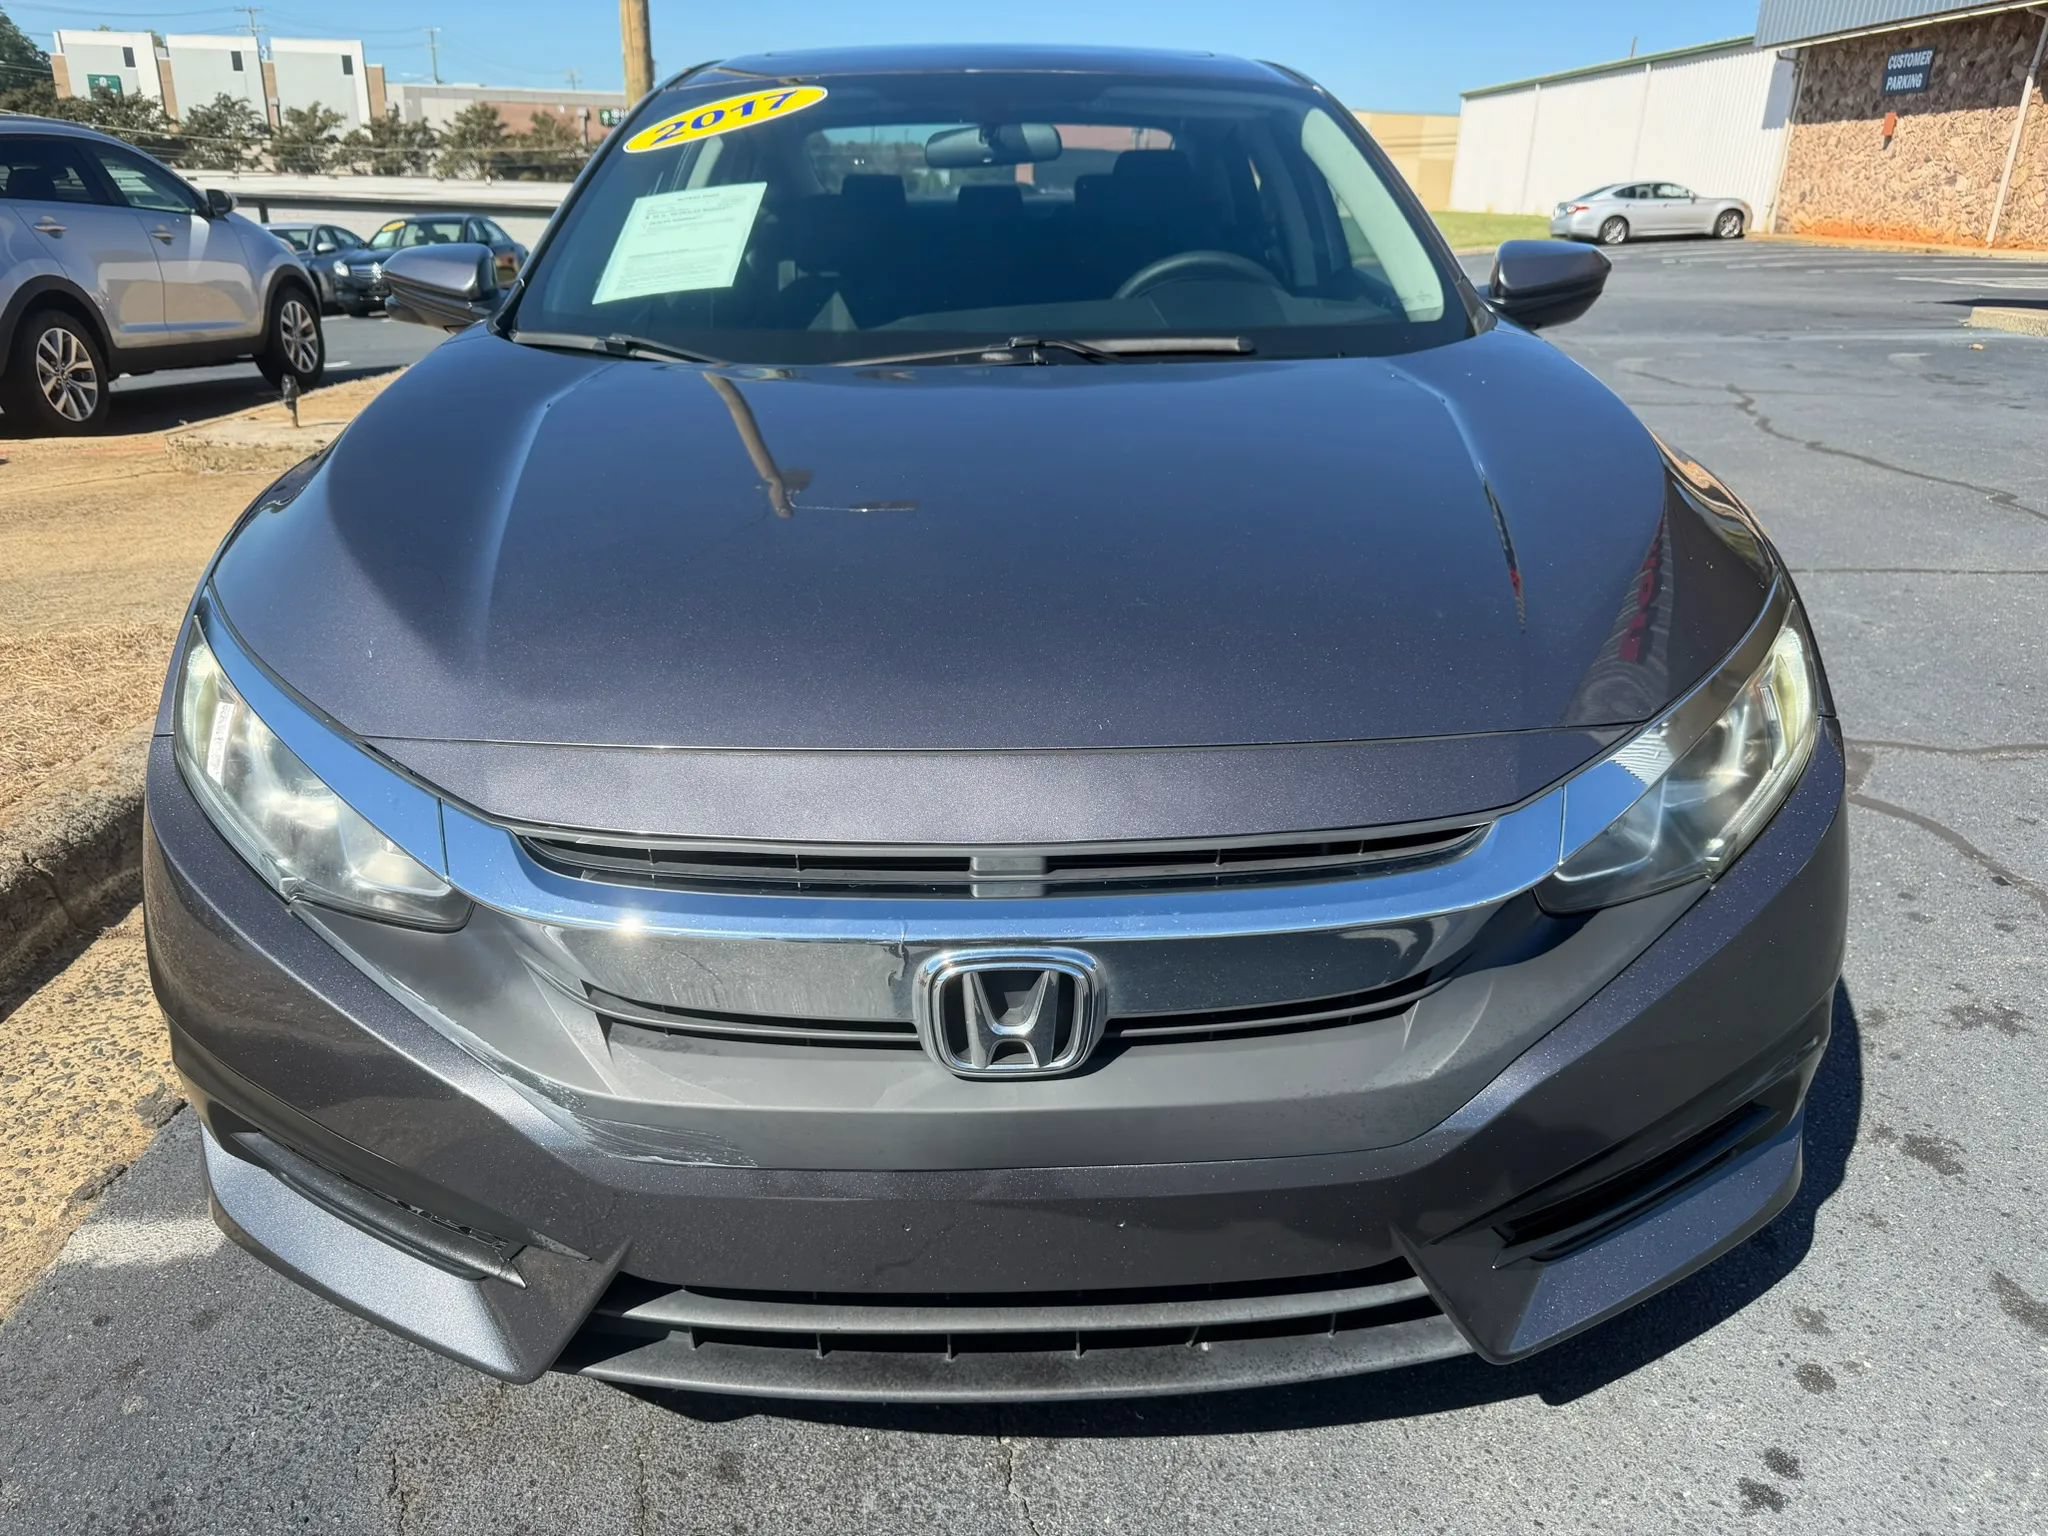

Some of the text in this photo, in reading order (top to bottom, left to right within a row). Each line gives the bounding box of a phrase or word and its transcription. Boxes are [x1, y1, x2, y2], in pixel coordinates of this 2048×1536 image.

[1887, 50, 1933, 70] CUSTOMER
[1885, 72, 1923, 91] PARKING
[650, 89, 798, 146] 2017
